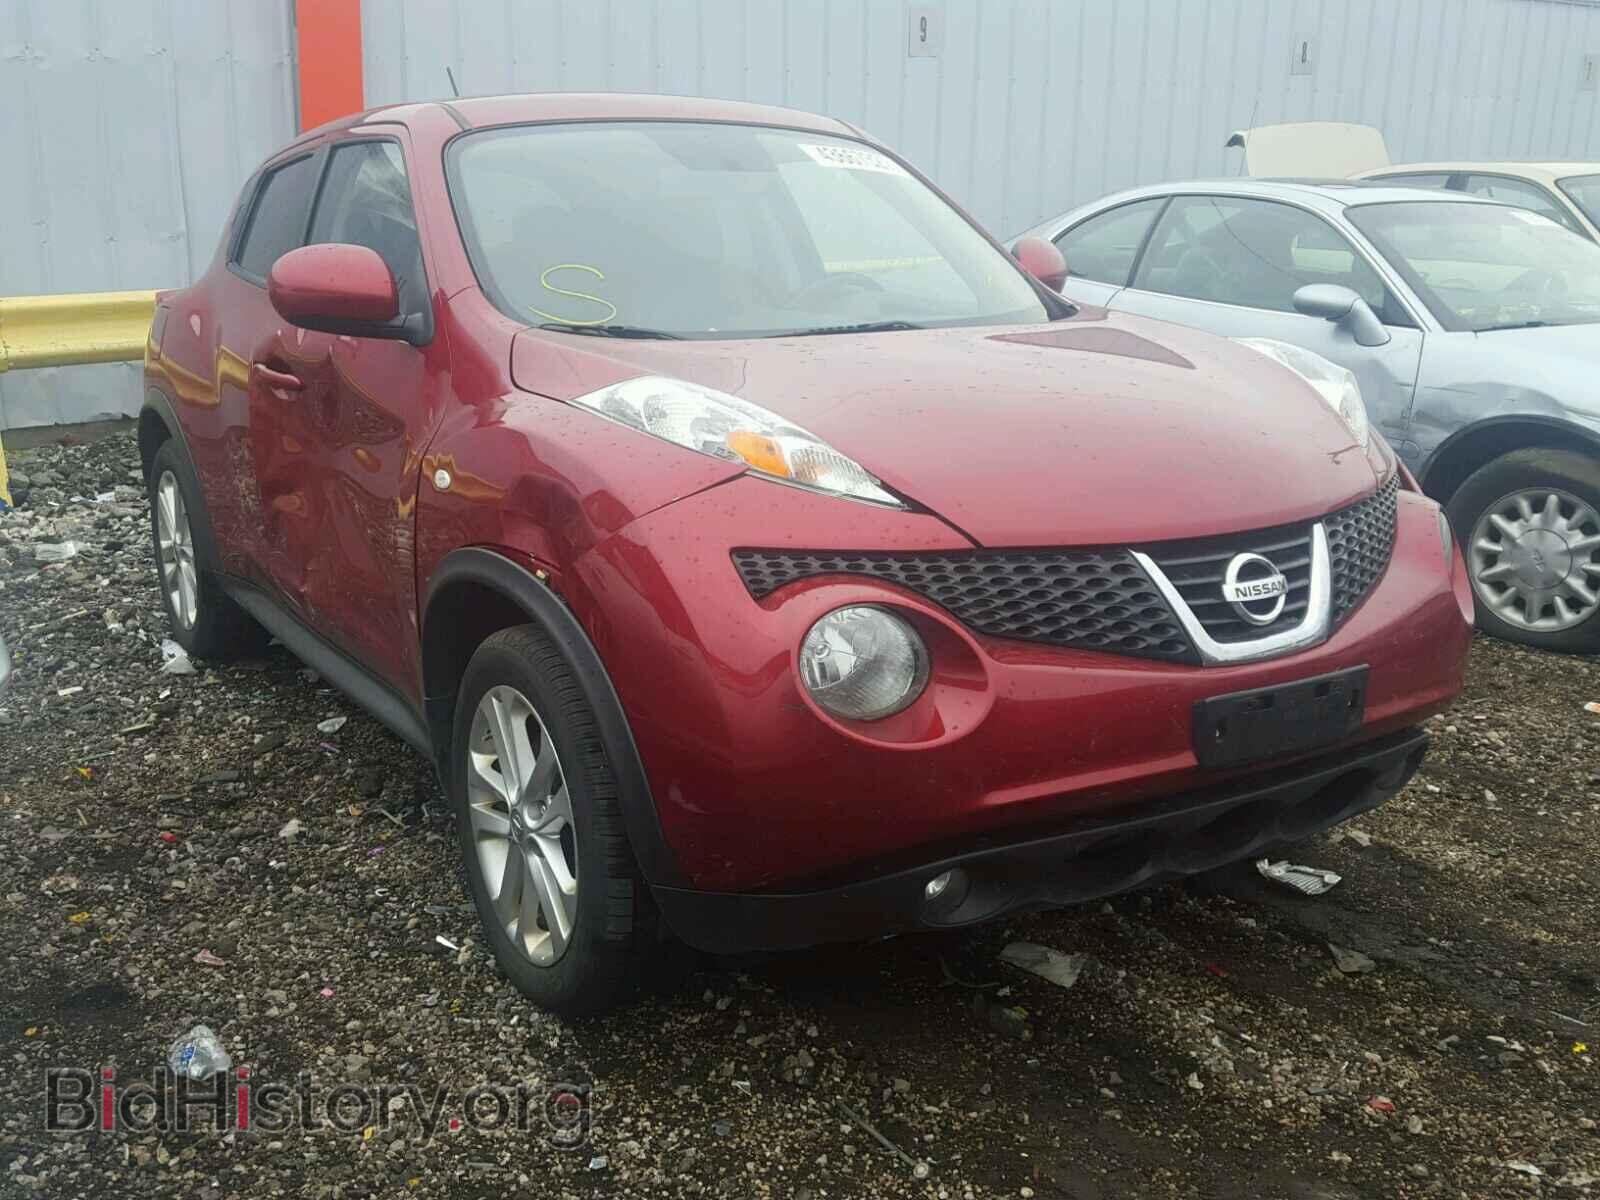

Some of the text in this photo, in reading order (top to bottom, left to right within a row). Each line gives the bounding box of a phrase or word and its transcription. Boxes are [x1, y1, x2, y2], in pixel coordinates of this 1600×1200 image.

[919, 15, 928, 43] 9
[1301, 40, 1308, 64] 8
[527, 264, 617, 325] S
[1234, 580, 1287, 599] NISSAN
